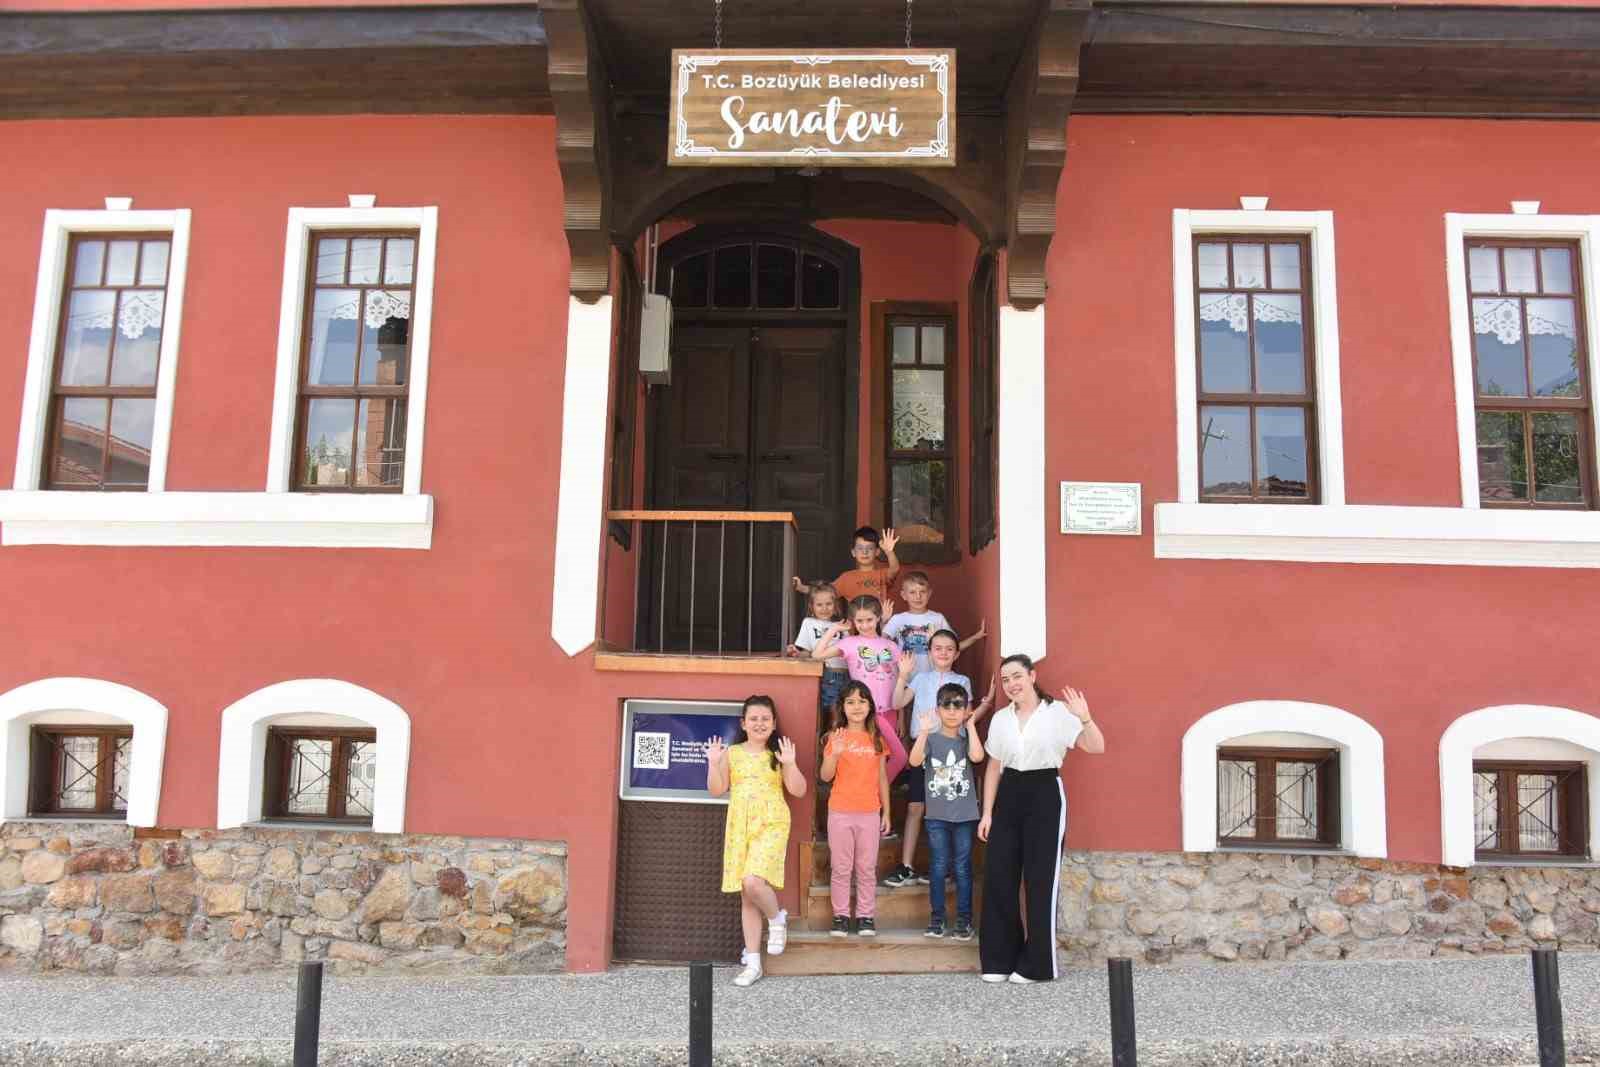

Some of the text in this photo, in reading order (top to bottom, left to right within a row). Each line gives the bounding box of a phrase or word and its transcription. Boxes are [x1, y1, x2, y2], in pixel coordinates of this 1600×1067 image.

[701, 74, 925, 91] T.C. Bozüyük Belediyesi
[720, 95, 903, 149] Sanatevi
